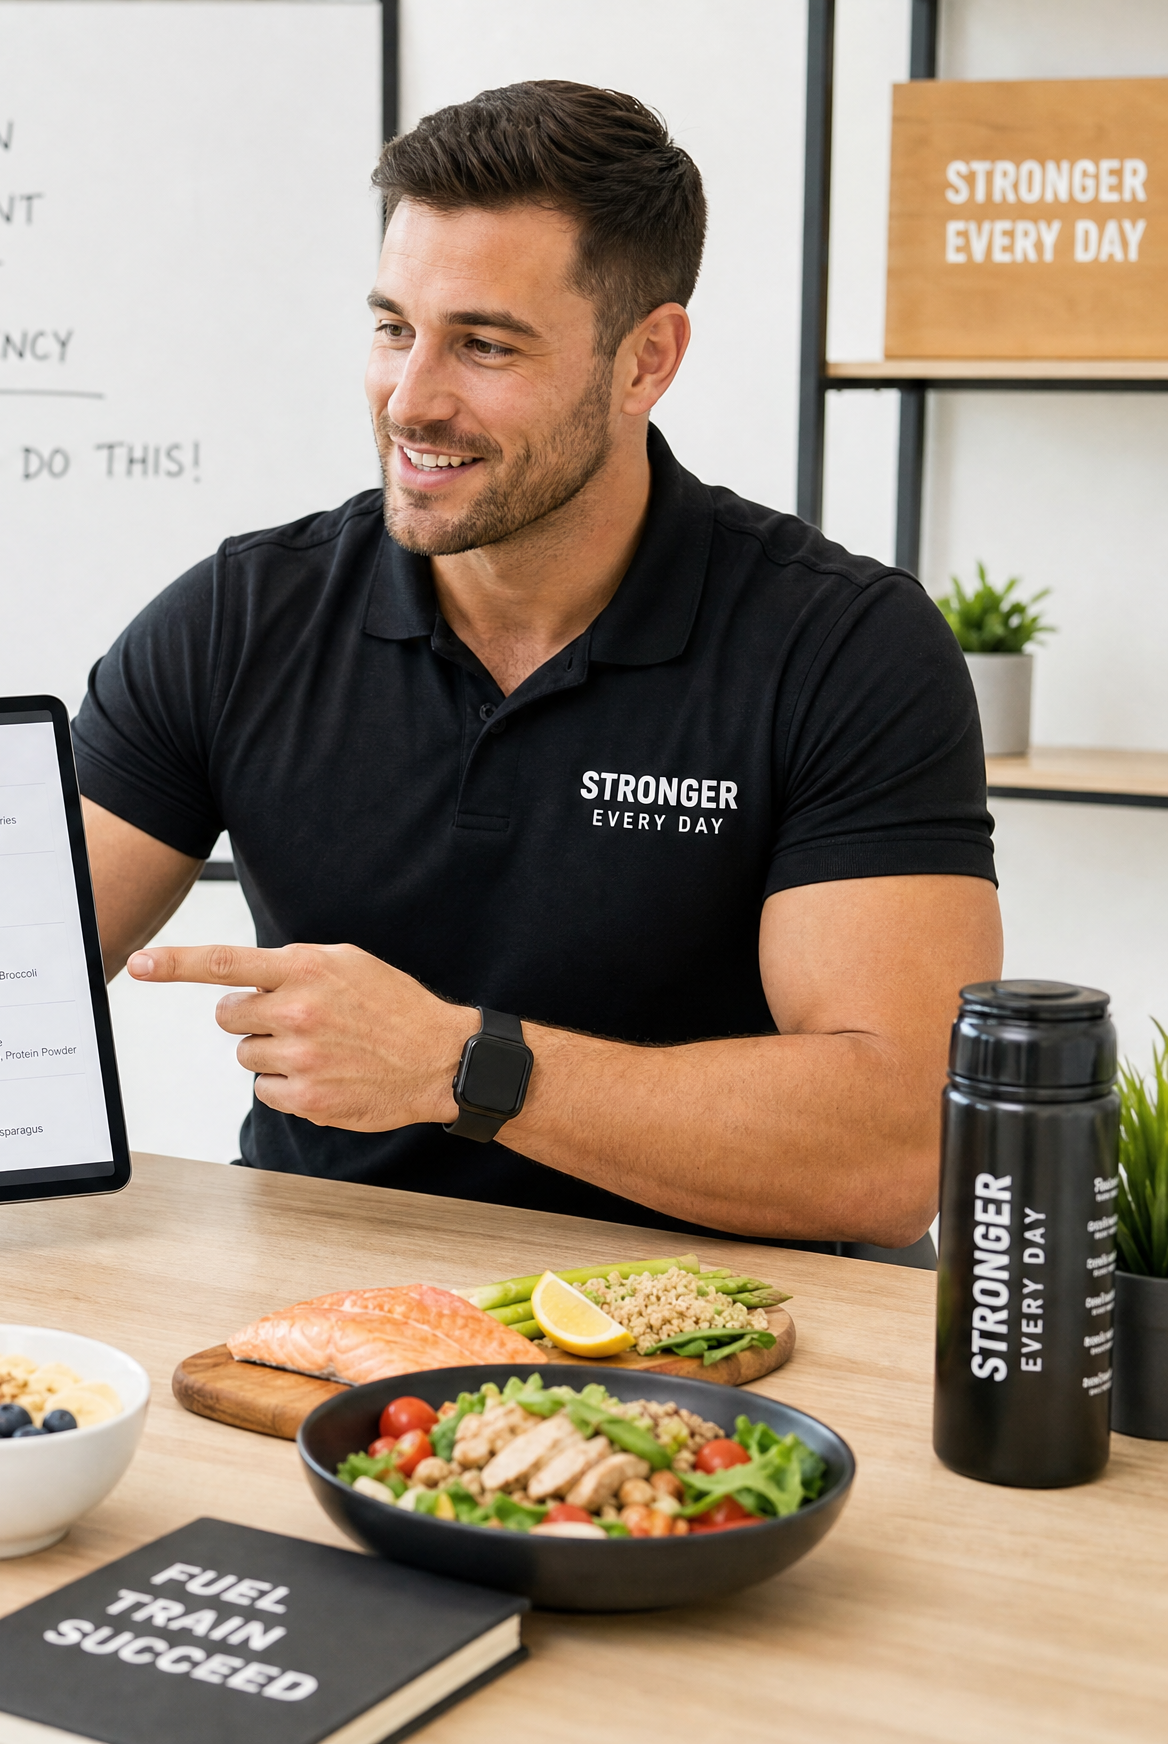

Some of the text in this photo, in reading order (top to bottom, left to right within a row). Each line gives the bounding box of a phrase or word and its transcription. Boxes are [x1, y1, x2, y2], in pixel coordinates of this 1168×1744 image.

[945, 158, 1147, 204] STRONGER
[945, 218, 1147, 263] EVERY DAY
[22, 445, 70, 481] DO
[95, 440, 200, 483] THIS!
[581, 771, 738, 809] STRONGER
[593, 809, 723, 834] EVERY DAY
[0, 969, 37, 980] Broccoli
[6, 1049, 38, 1060] Protein
[42, 1046, 77, 1057] Powder
[971, 1172, 1012, 1382] STRONGER
[1021, 1207, 1047, 1373] EVERY DAY
[150, 1562, 290, 1614] FUEL
[105, 1589, 287, 1652] TRAIN
[43, 1618, 319, 1702] SUCCEED
